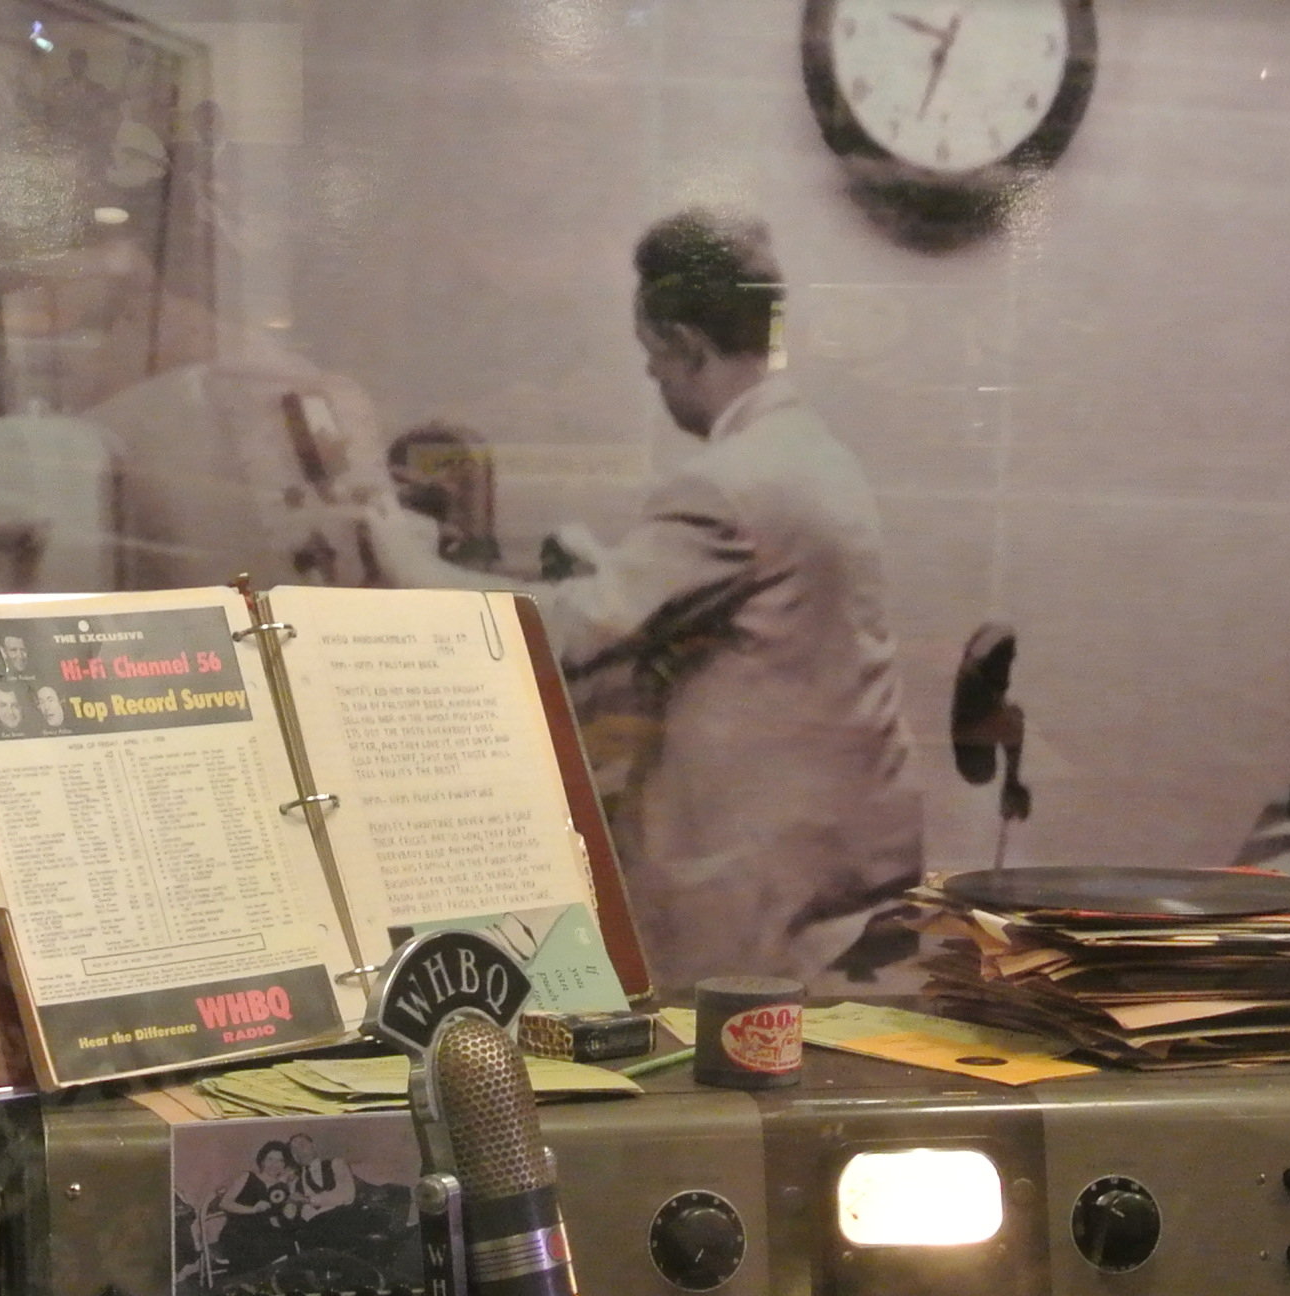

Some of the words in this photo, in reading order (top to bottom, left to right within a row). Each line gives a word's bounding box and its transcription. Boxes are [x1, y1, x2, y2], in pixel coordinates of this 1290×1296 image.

[53, 634, 76, 644] THE
[79, 631, 144, 643] EXCLUSIVE
[60, 656, 107, 681] Hi-Fi
[113, 652, 191, 679] Channel
[197, 649, 222, 673] 56
[69, 697, 108, 722] Top
[111, 690, 178, 715] Record
[180, 688, 247, 712] Survey
[397, 947, 509, 1026] WHBQ
[195, 985, 294, 1030] WHBQ
[78, 1036, 110, 1049] Hear
[112, 1031, 133, 1044] the
[134, 1022, 198, 1041] Difference
[222, 1024, 276, 1043] RADIO
